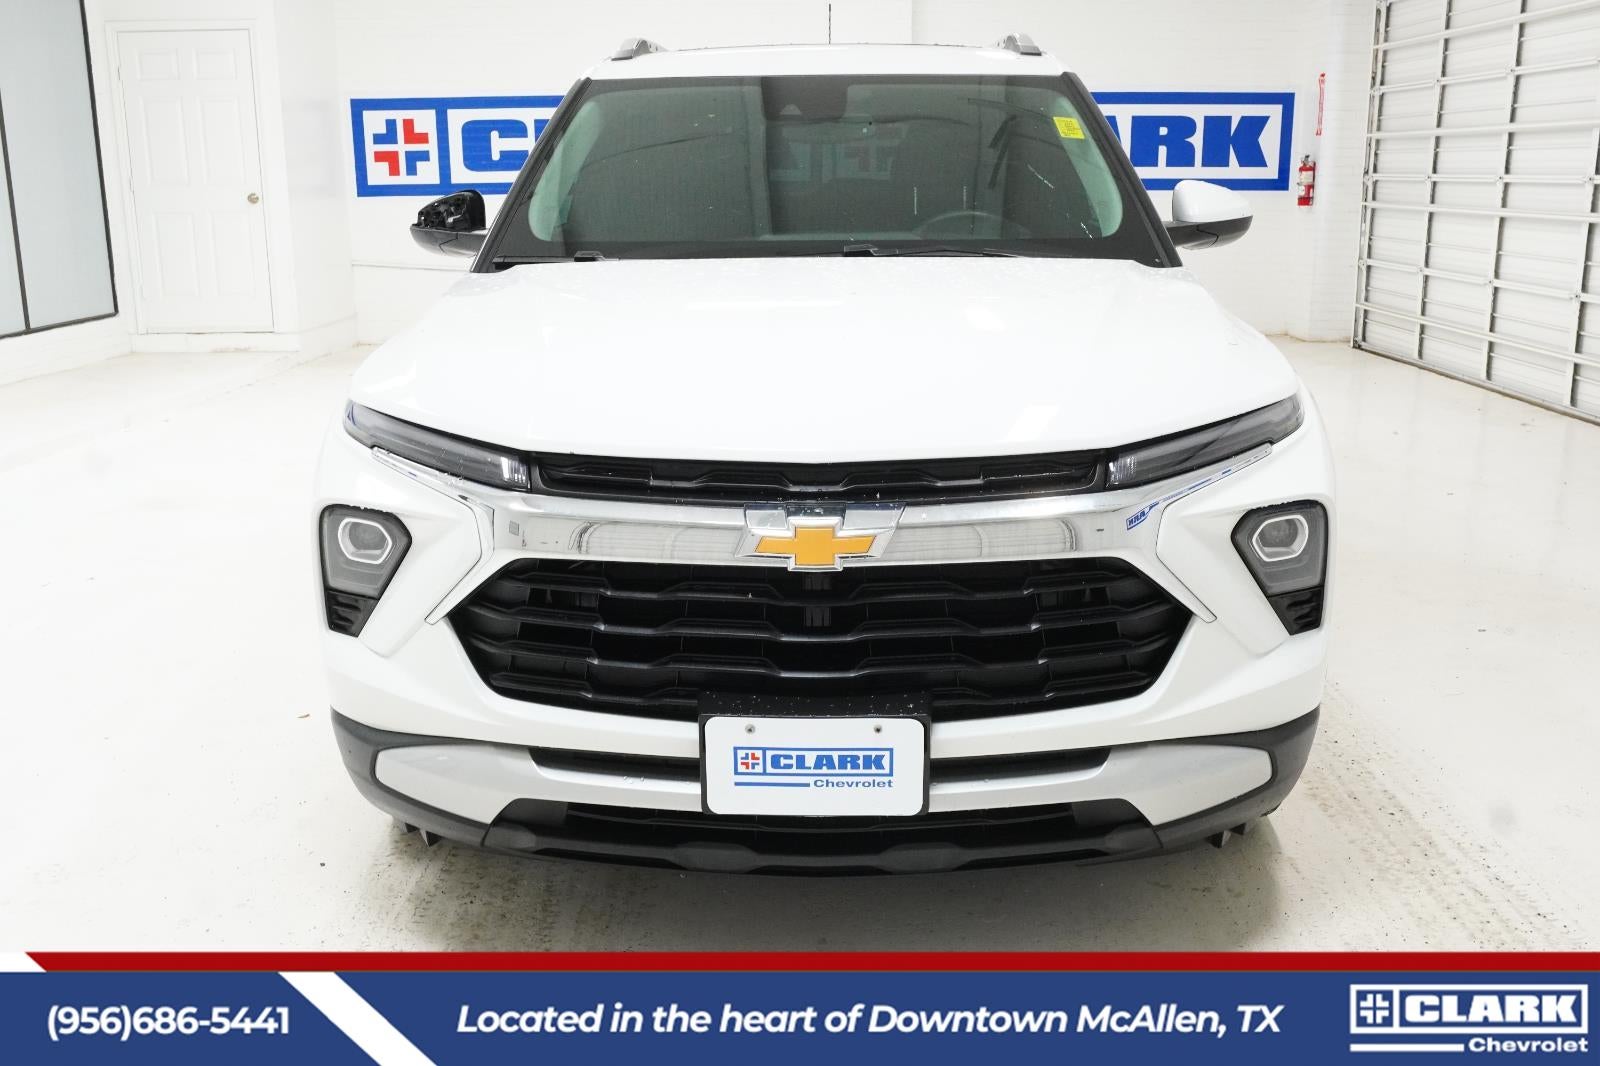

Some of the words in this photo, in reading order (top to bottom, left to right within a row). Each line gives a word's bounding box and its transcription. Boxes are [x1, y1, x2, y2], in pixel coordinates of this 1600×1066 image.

[1109, 115, 1270, 168] RK
[770, 753, 886, 771] CLARK
[813, 778, 894, 789] Chevrolet
